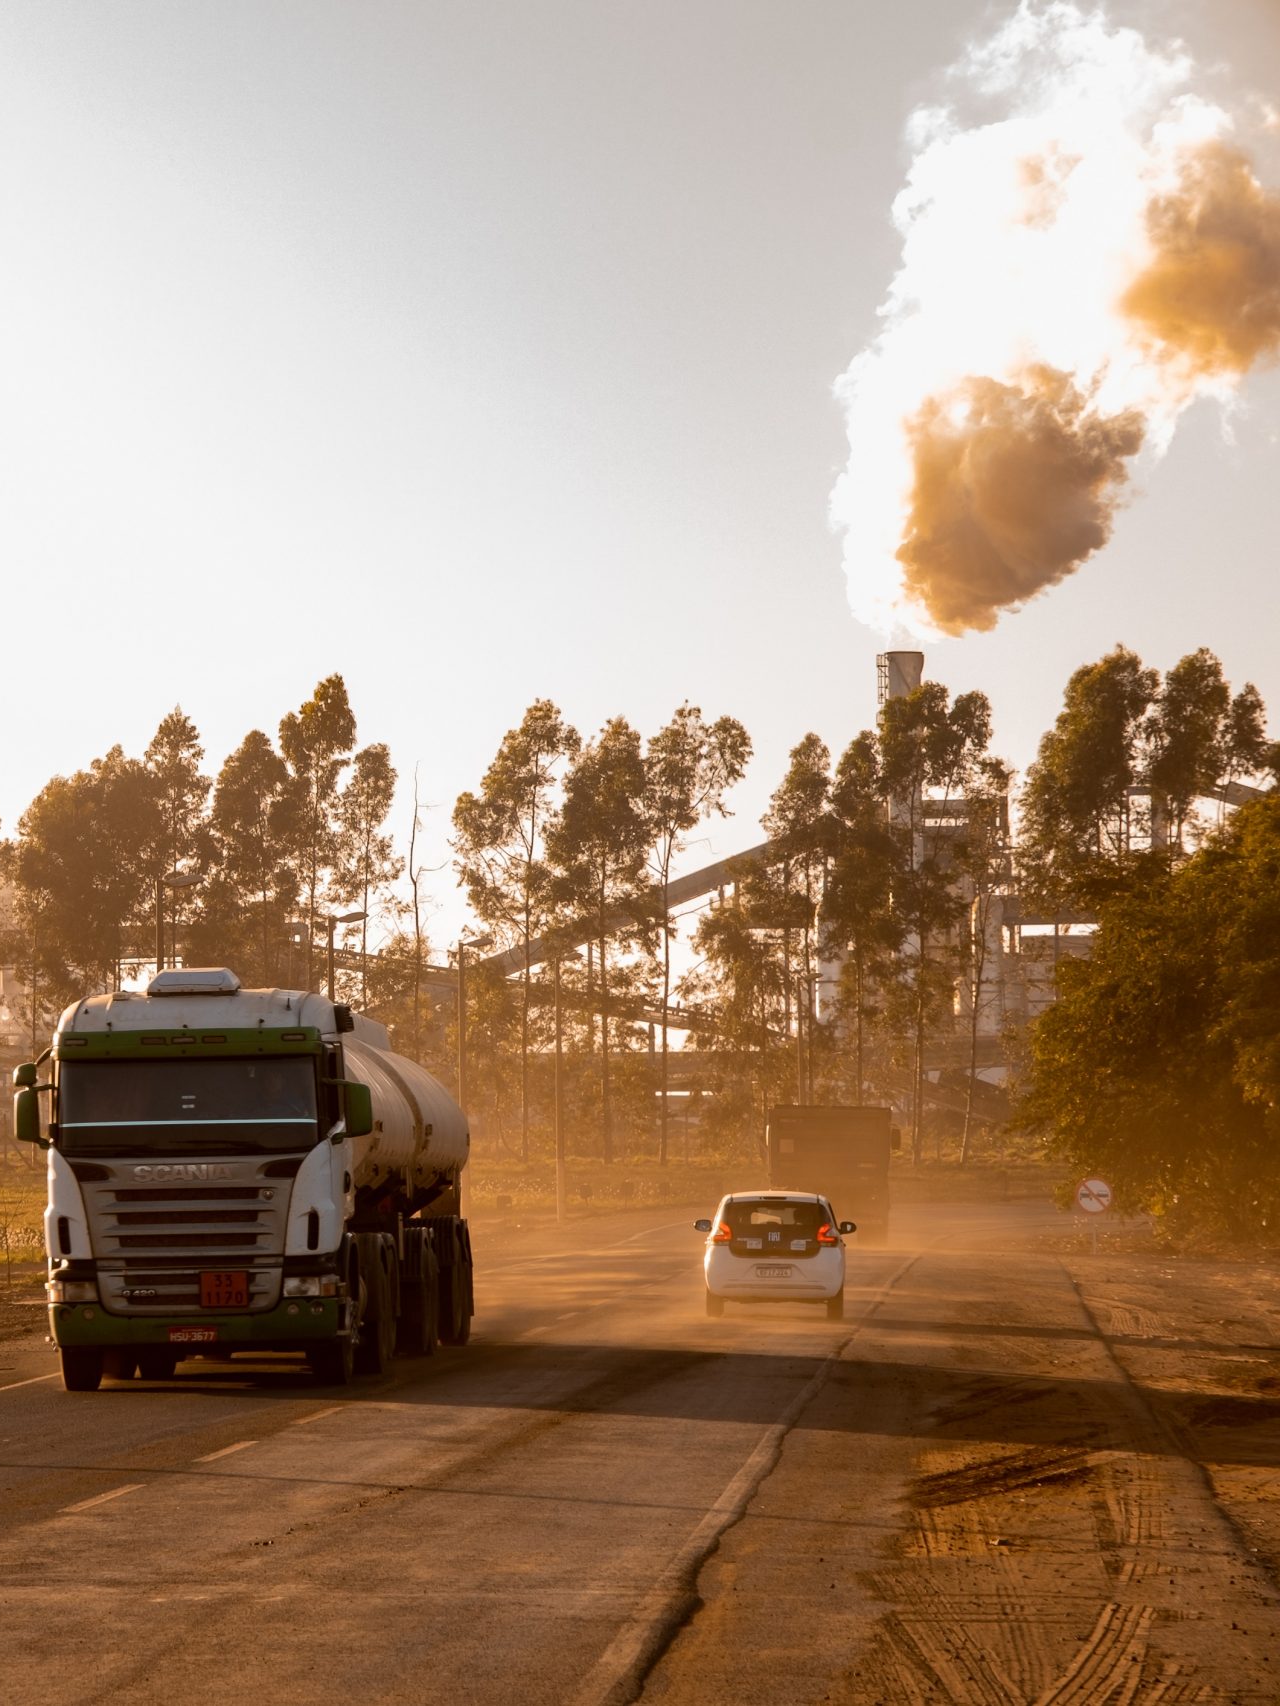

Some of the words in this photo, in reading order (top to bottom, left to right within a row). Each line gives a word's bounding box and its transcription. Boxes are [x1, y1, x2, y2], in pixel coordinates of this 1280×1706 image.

[133, 1164, 233, 1183] SCANIA
[768, 1231, 780, 1241] FIAT
[214, 1274, 232, 1288] 33
[132, 1289, 156, 1297] 420
[207, 1291, 243, 1304] 1170
